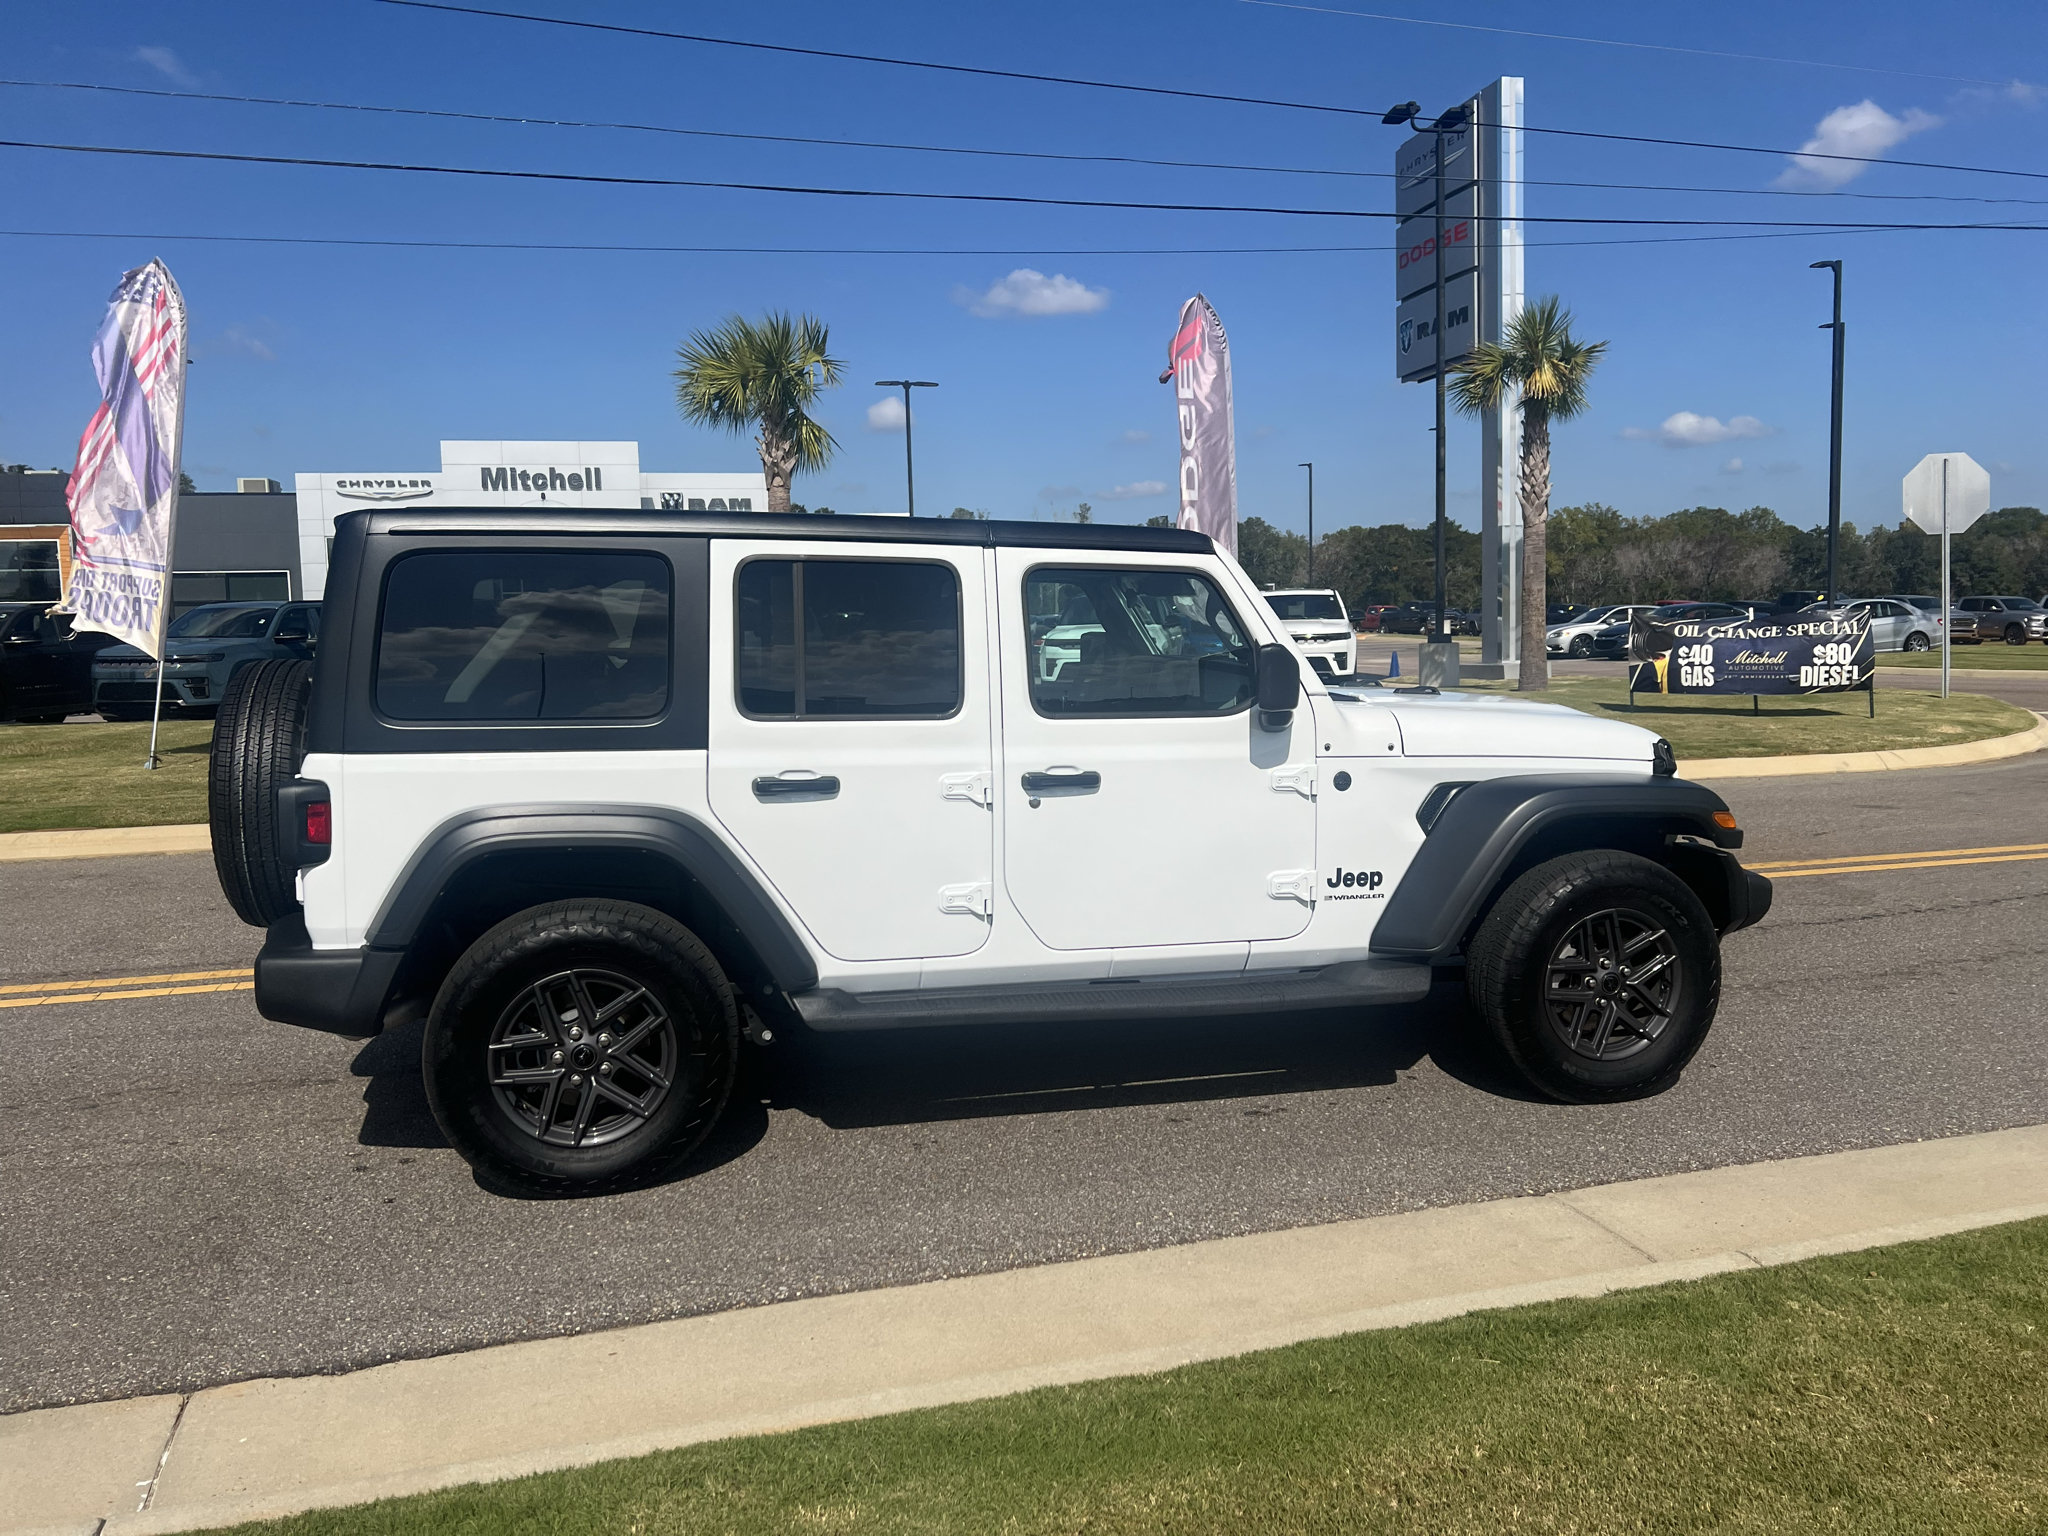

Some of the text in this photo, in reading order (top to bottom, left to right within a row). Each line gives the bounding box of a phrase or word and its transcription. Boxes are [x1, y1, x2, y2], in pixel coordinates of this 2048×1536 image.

[1400, 131, 1465, 175] CHRYSER
[336, 479, 432, 488] CHRYSLER
[480, 467, 602, 491] Mitchell
[1674, 620, 1863, 639] OIL CHANGE SPECIAL
[1677, 644, 1714, 667] $40
[1725, 649, 1788, 664] Mitchell
[1812, 642, 1852, 666] $80
[1680, 665, 1715, 687] GAS
[1326, 867, 1384, 891] Jeep
